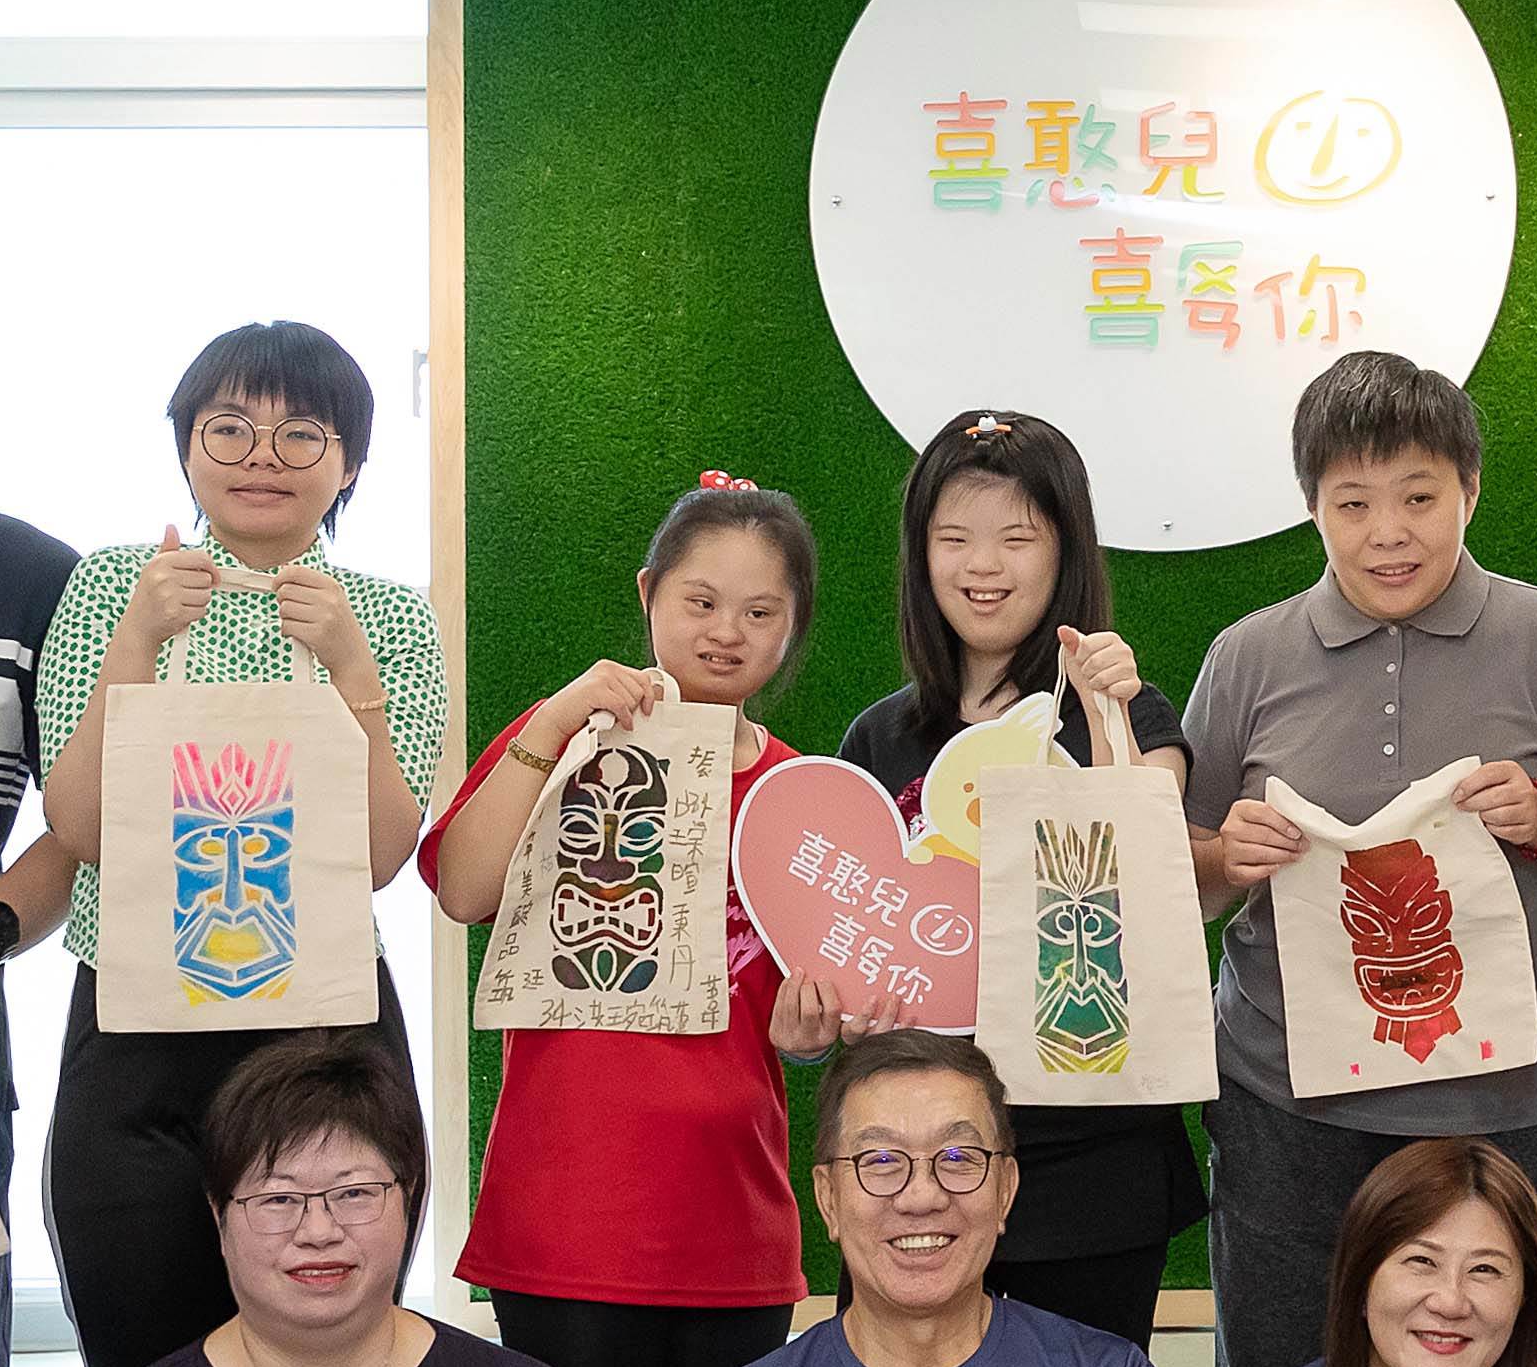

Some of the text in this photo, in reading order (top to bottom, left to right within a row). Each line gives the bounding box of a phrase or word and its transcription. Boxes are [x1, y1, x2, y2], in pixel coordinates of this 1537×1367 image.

[922, 91, 1226, 213] 喜憨兒
[788, 829, 910, 927] 喜憨兒
